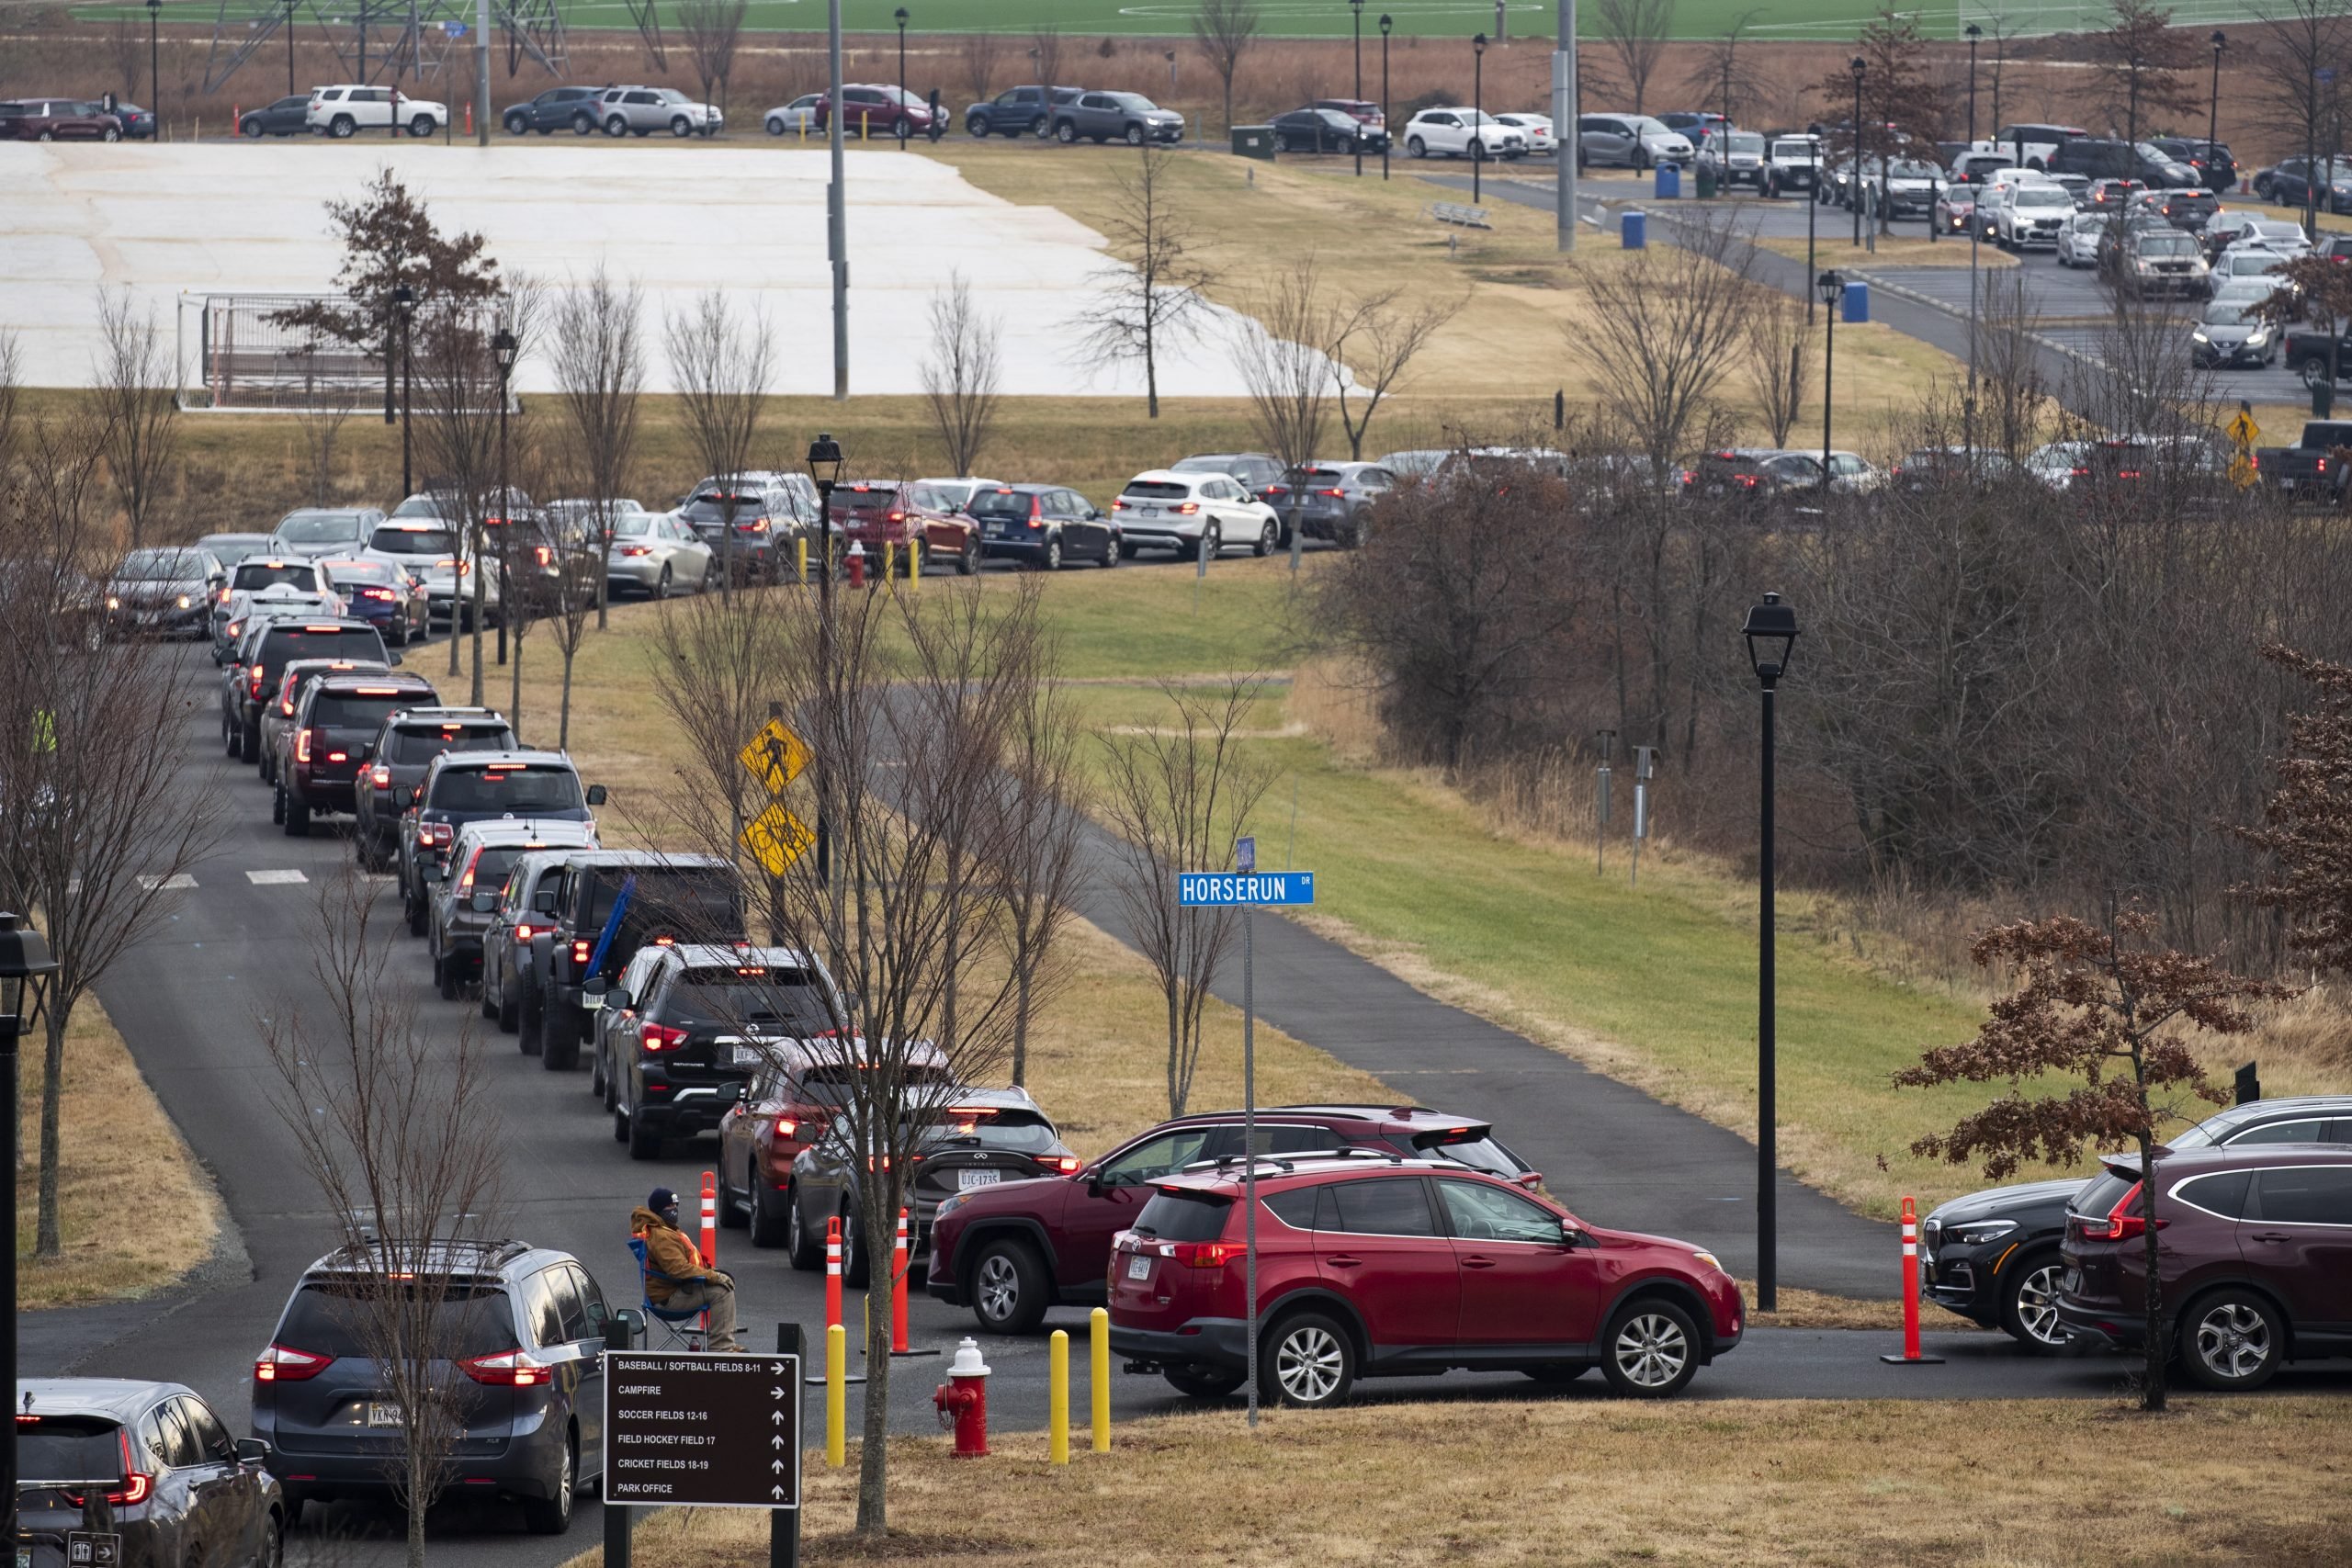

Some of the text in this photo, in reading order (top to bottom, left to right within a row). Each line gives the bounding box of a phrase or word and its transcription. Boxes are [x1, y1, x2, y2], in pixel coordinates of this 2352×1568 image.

[1183, 876, 1310, 901] HORSERUN DR
[618, 1361, 662, 1371] BASEBALL
[669, 1362, 712, 1371] SOFTBALL
[714, 1363, 743, 1372] FIELDS
[745, 1364, 761, 1372] 8-11
[618, 1385, 661, 1394] CAMPFIRE
[618, 1410, 707, 1420] SOCCER FIELDS 12-16
[618, 1435, 716, 1445] FIELD HOCKEY FIELD 17
[618, 1460, 708, 1470] CRICKET FIELDS 18-19
[618, 1483, 673, 1493] PARK OFFICE
